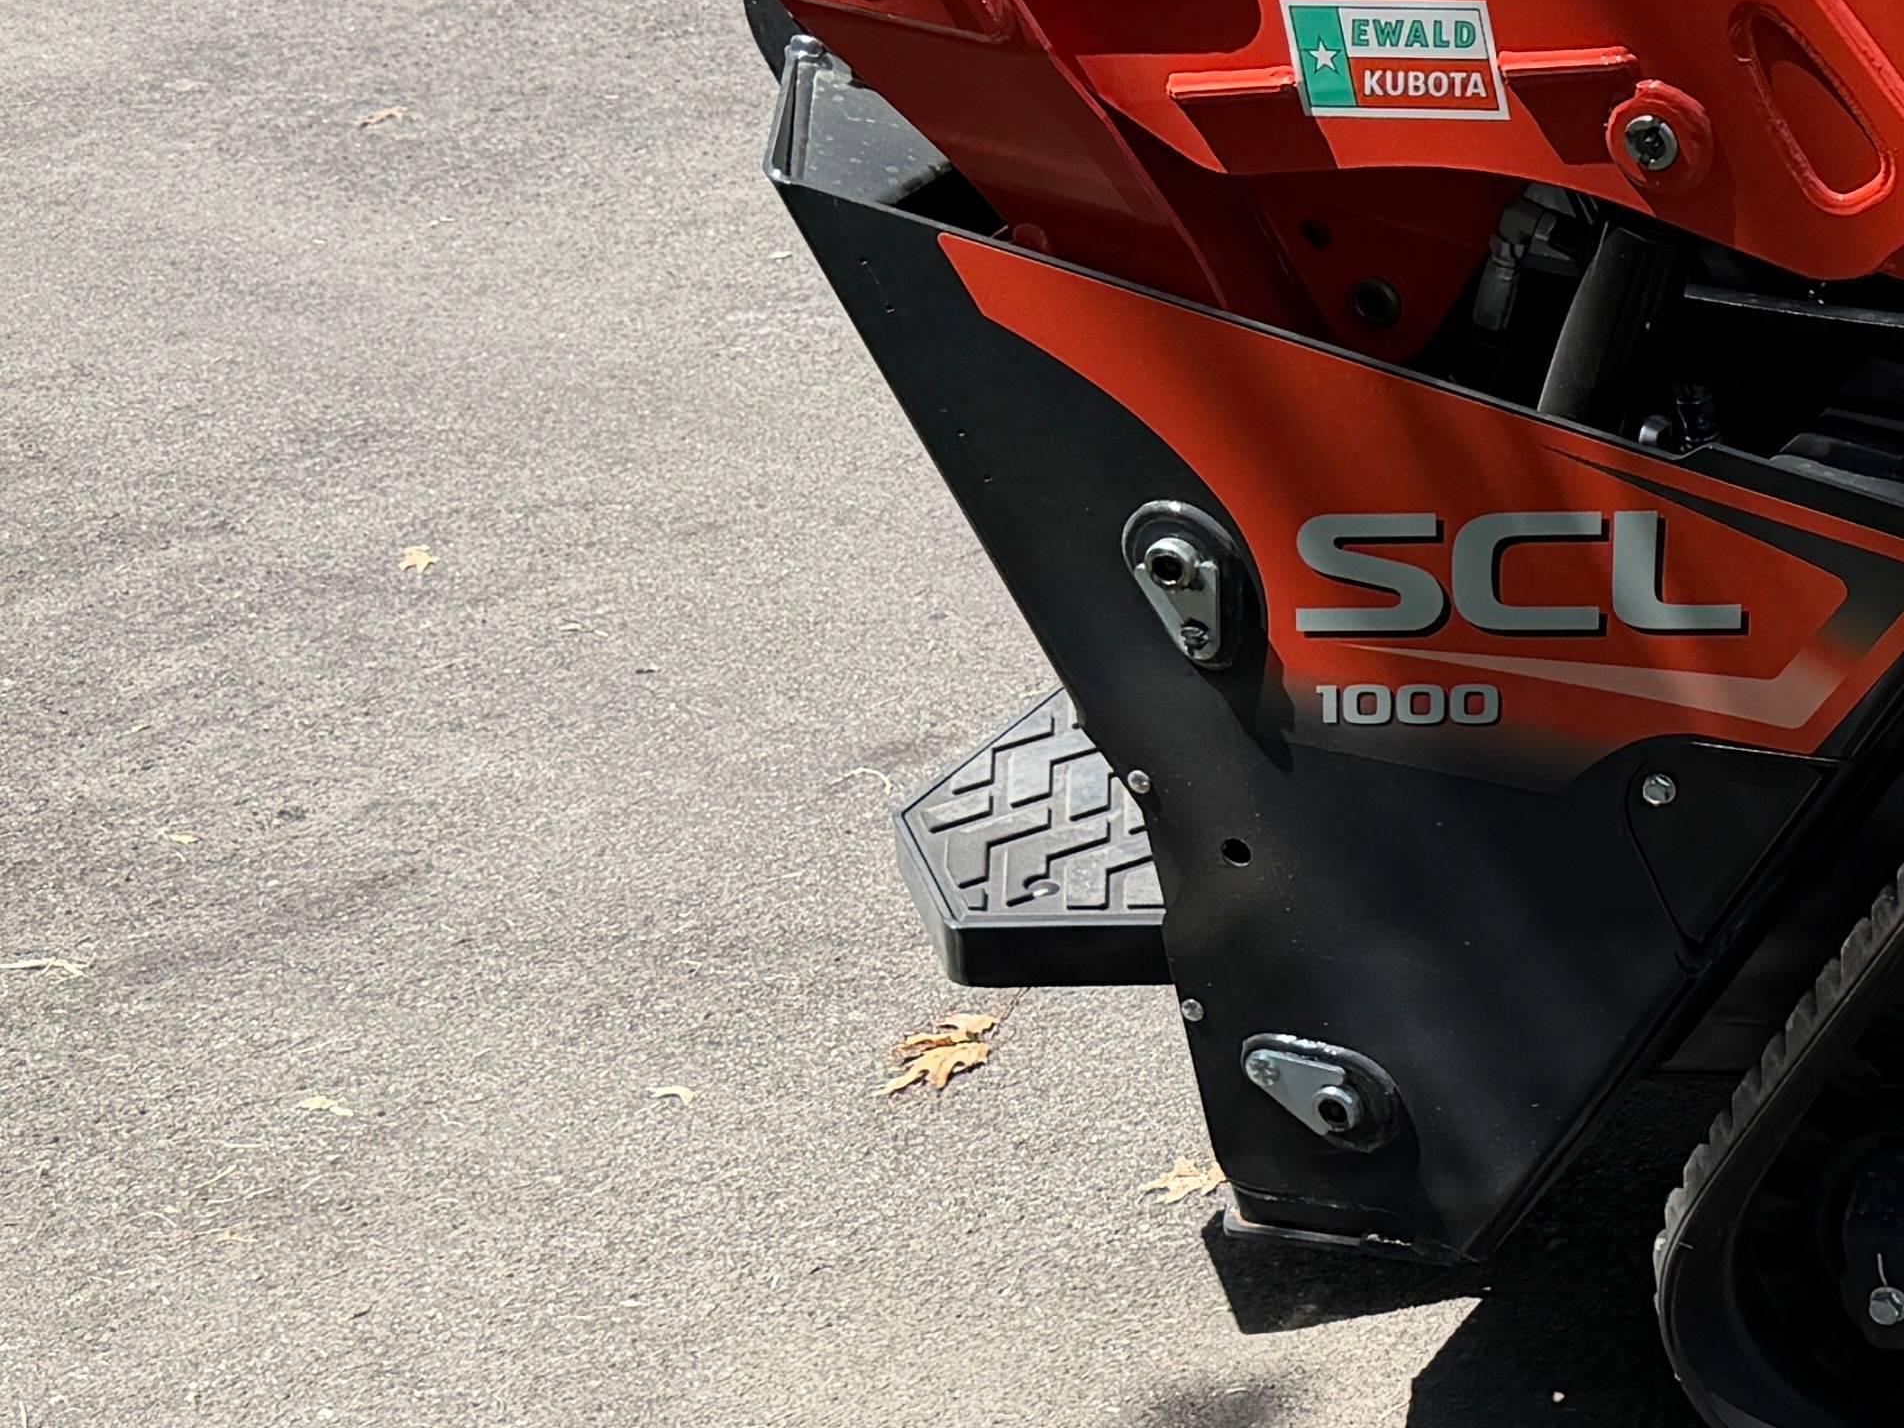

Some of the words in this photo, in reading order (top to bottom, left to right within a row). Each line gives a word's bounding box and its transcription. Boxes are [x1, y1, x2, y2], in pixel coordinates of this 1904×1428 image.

[1350, 18, 1477, 49] EWALD
[1362, 69, 1488, 99] KUBOTA
[1295, 509, 1745, 634] SCL
[1316, 683, 1502, 727] 1000
